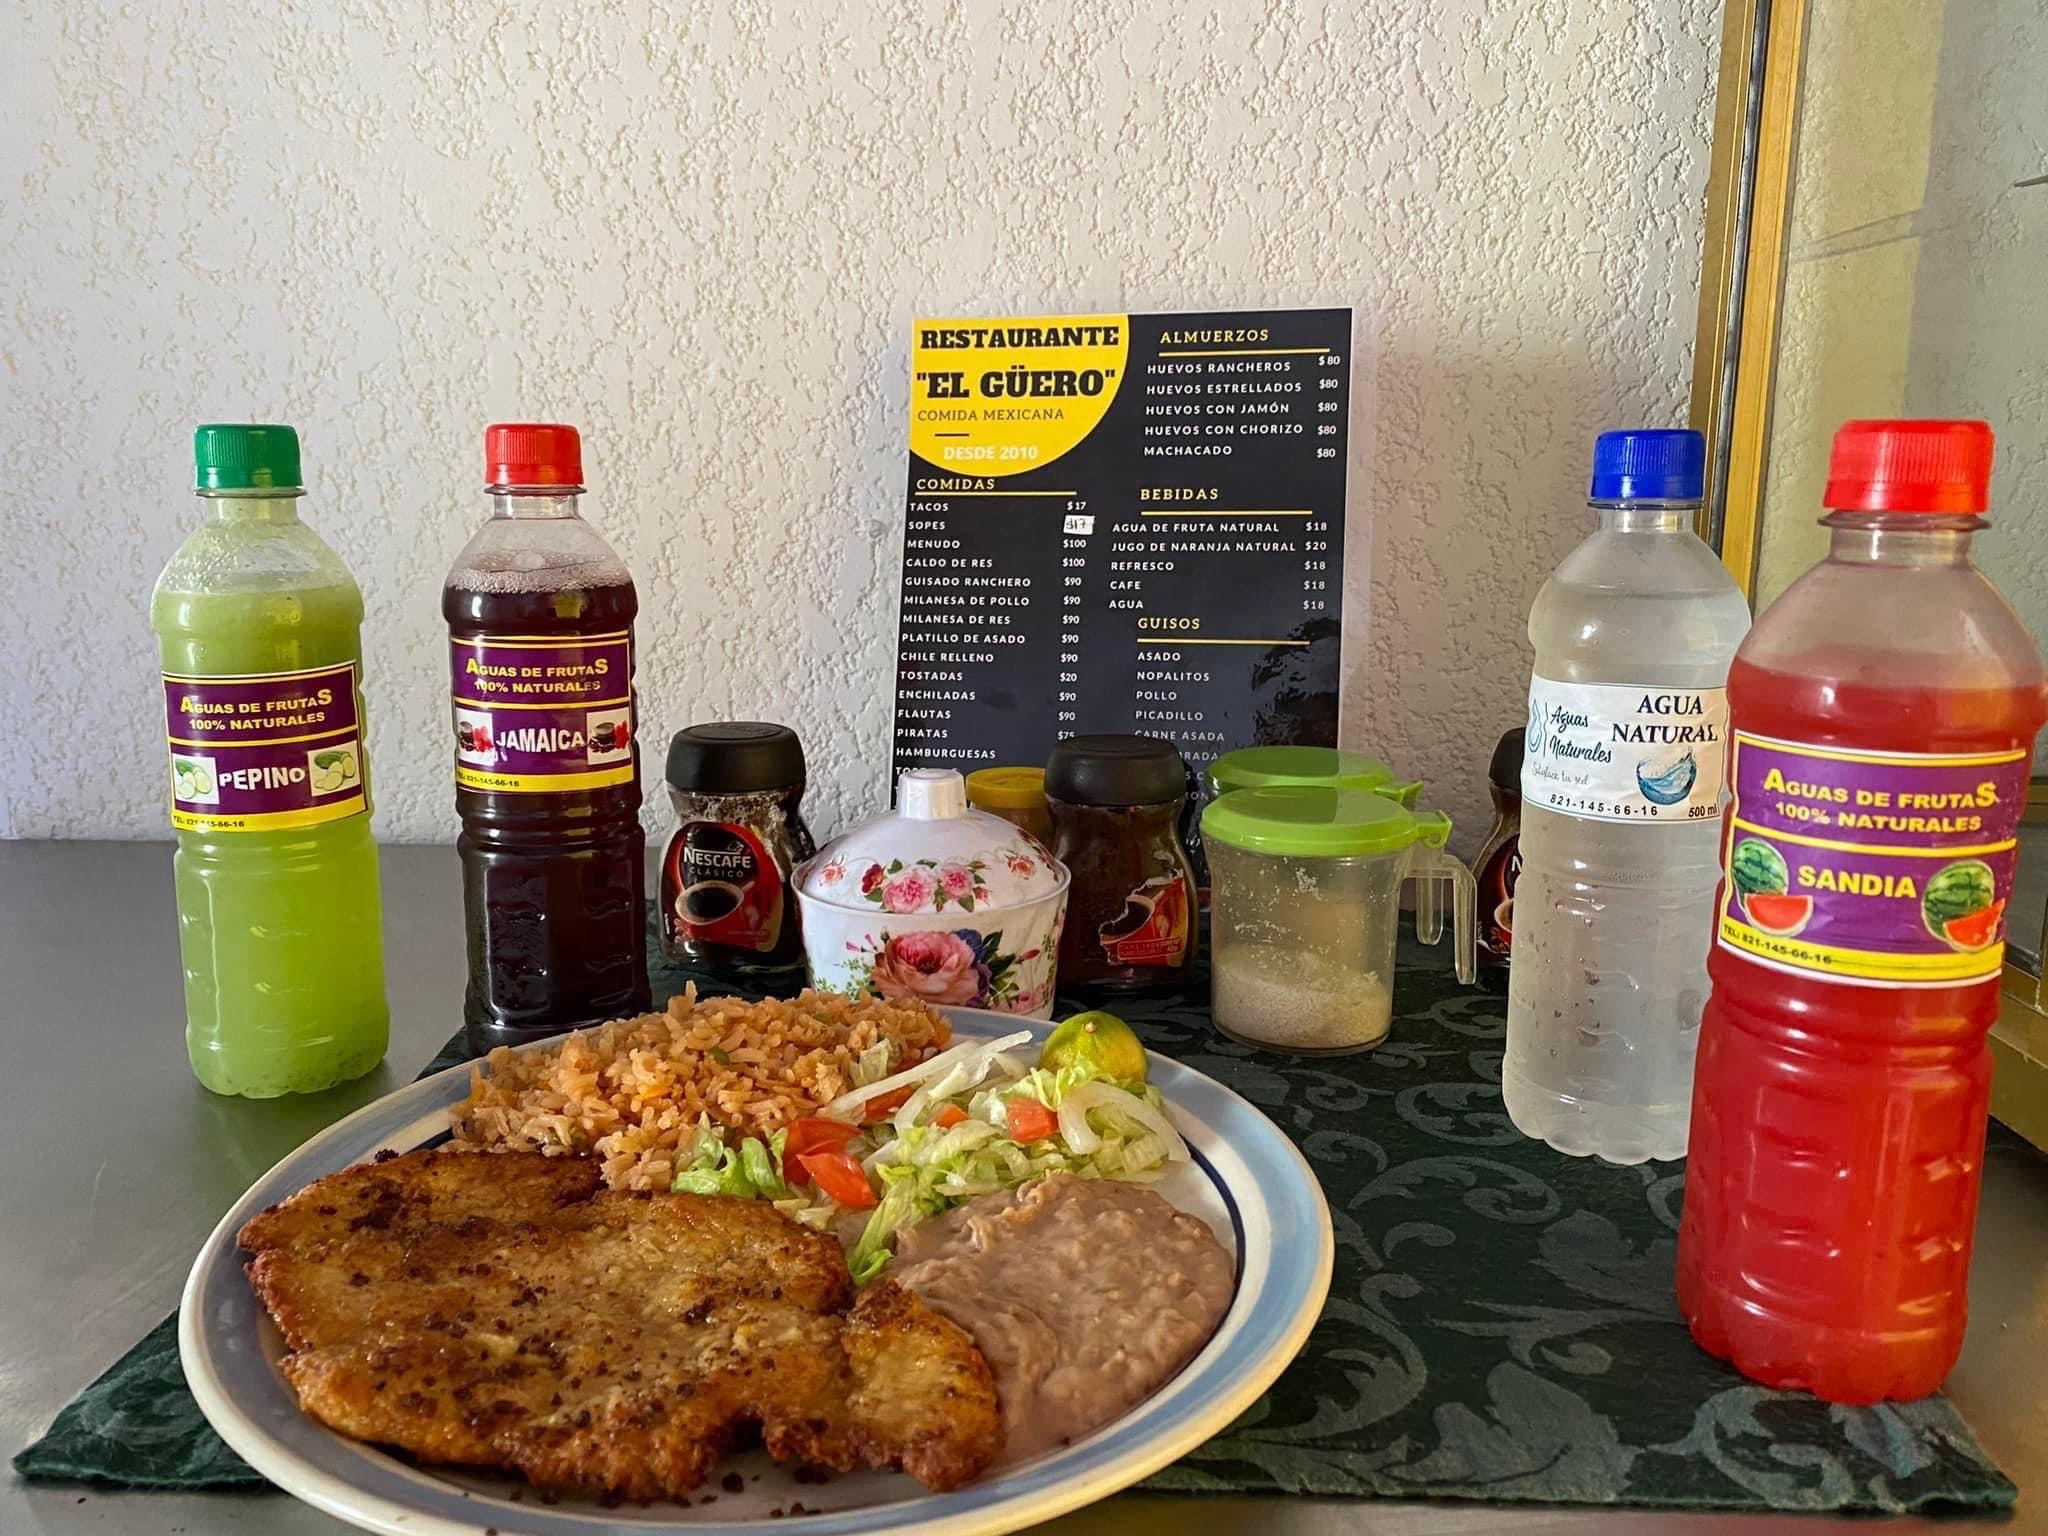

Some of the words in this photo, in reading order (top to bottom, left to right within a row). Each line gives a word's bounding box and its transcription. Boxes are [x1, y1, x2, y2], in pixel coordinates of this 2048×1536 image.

[920, 326, 1119, 349] RESTAURANTE
[1160, 329, 1269, 344] ALMUERZOS
[1147, 363, 1202, 374] HUEVOS
[1208, 361, 1291, 373] RANCHEROS
[917, 371, 970, 398] "EL
[980, 365, 1115, 398] GÜERO"
[1319, 379, 1338, 389] $80
[1146, 384, 1202, 395] HUEVOS
[1207, 382, 1302, 394] ESTRELLADOS
[1145, 405, 1201, 415] HUEVOS
[1206, 404, 1235, 414] CON
[1240, 401, 1289, 414] JAMÓN
[1317, 402, 1338, 412] $80
[917, 409, 977, 422] COMIDA
[983, 408, 1065, 421] MEXICANA
[1144, 425, 1200, 436] HUEVOS
[1205, 425, 1234, 435] CON
[1240, 424, 1303, 435] CHORIZO
[1317, 425, 1336, 435] $80
[943, 446, 996, 461] DESDE
[1000, 445, 1039, 460] 2010
[1144, 445, 1233, 456] MACHACADO
[1316, 448, 1336, 458] $80
[916, 478, 996, 491] COMIDAS
[1140, 488, 1219, 501] BEBIDAS
[909, 502, 949, 512] TACOS
[908, 520, 946, 530] SOPES
[1112, 522, 1147, 533] AGUA
[1152, 523, 1168, 533] DE
[1173, 522, 1214, 533] FRUTA
[1219, 522, 1280, 533] NATURAL
[1305, 521, 1328, 532] $18
[906, 539, 961, 549] MENUDO
[1063, 538, 1087, 549] $100
[1111, 542, 1145, 552] JUGO
[1150, 542, 1166, 552] DE
[1171, 542, 1231, 552] NARANJA
[1236, 542, 1296, 552] NATURAL
[1304, 541, 1327, 551] $20
[905, 558, 946, 568] CALDO
[950, 558, 967, 568] DE
[971, 558, 993, 568] RES
[1062, 557, 1086, 568] $100
[1110, 561, 1175, 571] REFRESCO
[1304, 560, 1326, 570] $18
[904, 576, 960, 586] GUISADO
[964, 577, 1032, 588] RANCHERO
[1063, 577, 1082, 587] $90
[1109, 580, 1142, 590] CAFE
[1303, 580, 1325, 590] $18
[903, 596, 965, 606] MILANESA
[969, 596, 986, 606] DE
[990, 596, 1030, 607] POLLO
[1063, 596, 1081, 606] $90
[1108, 600, 1144, 609] AGUA
[1302, 600, 1325, 610] $18
[902, 614, 964, 625] MILANESA
[968, 615, 985, 625] DE
[989, 615, 1011, 625] RES
[1062, 615, 1080, 625] $90
[1137, 617, 1201, 630] GUISOS
[901, 633, 959, 643] PLATILLO
[963, 634, 980, 643] DE
[983, 634, 1026, 644] ASADO
[1061, 634, 1079, 644] $90
[900, 652, 936, 662] CHILE
[940, 652, 994, 663] RELLENO
[1060, 653, 1078, 663] $90
[1137, 652, 1181, 662] ASADO
[466, 658, 517, 678] AGUAS
[520, 667, 543, 678] DE
[546, 658, 609, 678] FRUTAS
[899, 671, 964, 681] TOSTADAS
[1060, 672, 1078, 682] $20
[1136, 671, 1211, 682] NOPALITOS
[474, 679, 509, 693] 100%
[512, 680, 601, 693] NATURALES
[180, 695, 235, 714] AGUAS
[239, 702, 261, 714] DE
[266, 688, 333, 712] FRUTAS
[898, 690, 976, 701] ENCHILADAS
[1058, 692, 1077, 701] $90
[1136, 691, 1177, 701] POLLO
[1636, 694, 1704, 715] AGUA
[897, 709, 951, 720] FLAUTAS
[1058, 711, 1076, 721] $90
[1135, 710, 1204, 721] PICADILLO
[1550, 705, 1589, 733] Aguas
[188, 718, 226, 731] 100%
[230, 711, 326, 731] NATURALES
[897, 728, 948, 739] PIRATAS
[1181, 730, 1225, 742] ASADA
[1610, 723, 1718, 744] NATURAL
[496, 728, 585, 753] JAMAICA
[895, 748, 996, 759] HAMBURGUESAS
[1549, 735, 1612, 763] Naturales
[218, 767, 306, 791] PEPINO
[1763, 768, 1849, 804] AGUAS
[1856, 789, 1891, 808] DE
[1897, 781, 1998, 810] FRUTAS
[1549, 793, 1658, 816] 821-145-66-16
[1688, 806, 1706, 818] 500
[1707, 805, 1718, 816] ml
[1775, 801, 1831, 826] 100%
[1838, 812, 1982, 833] NATURALES
[1797, 864, 1917, 899] SANDIA
